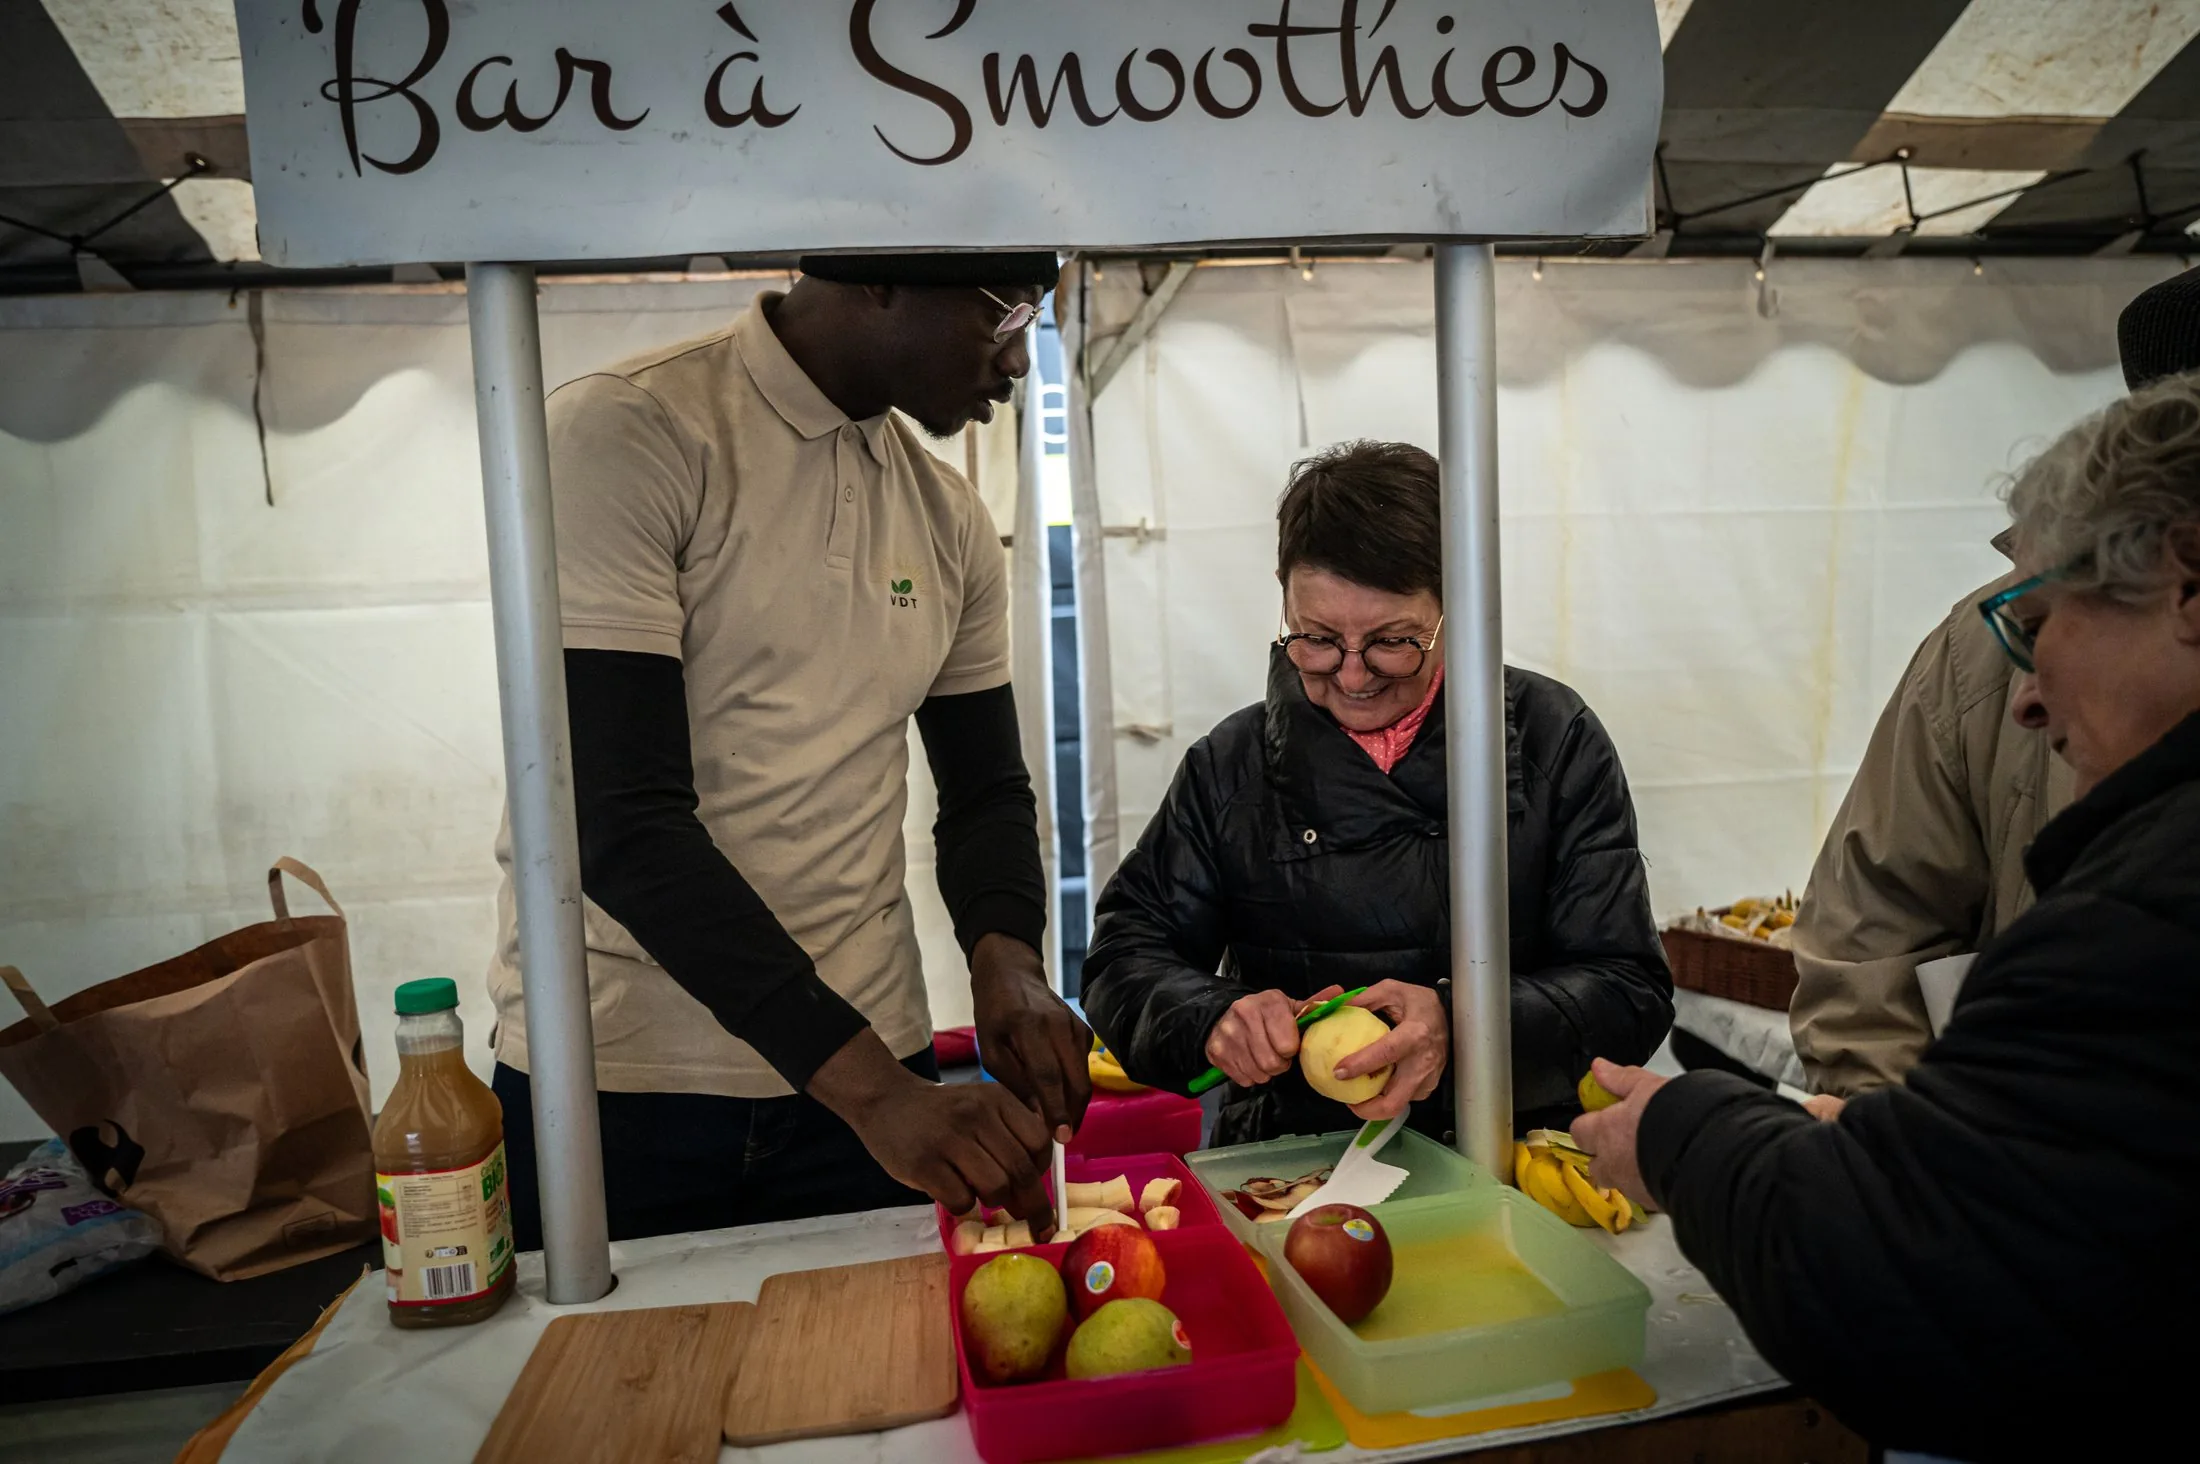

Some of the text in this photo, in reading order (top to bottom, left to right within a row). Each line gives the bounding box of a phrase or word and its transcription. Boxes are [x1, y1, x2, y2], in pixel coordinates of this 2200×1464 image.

[302, 0, 1609, 178] Bar à Smoothies
